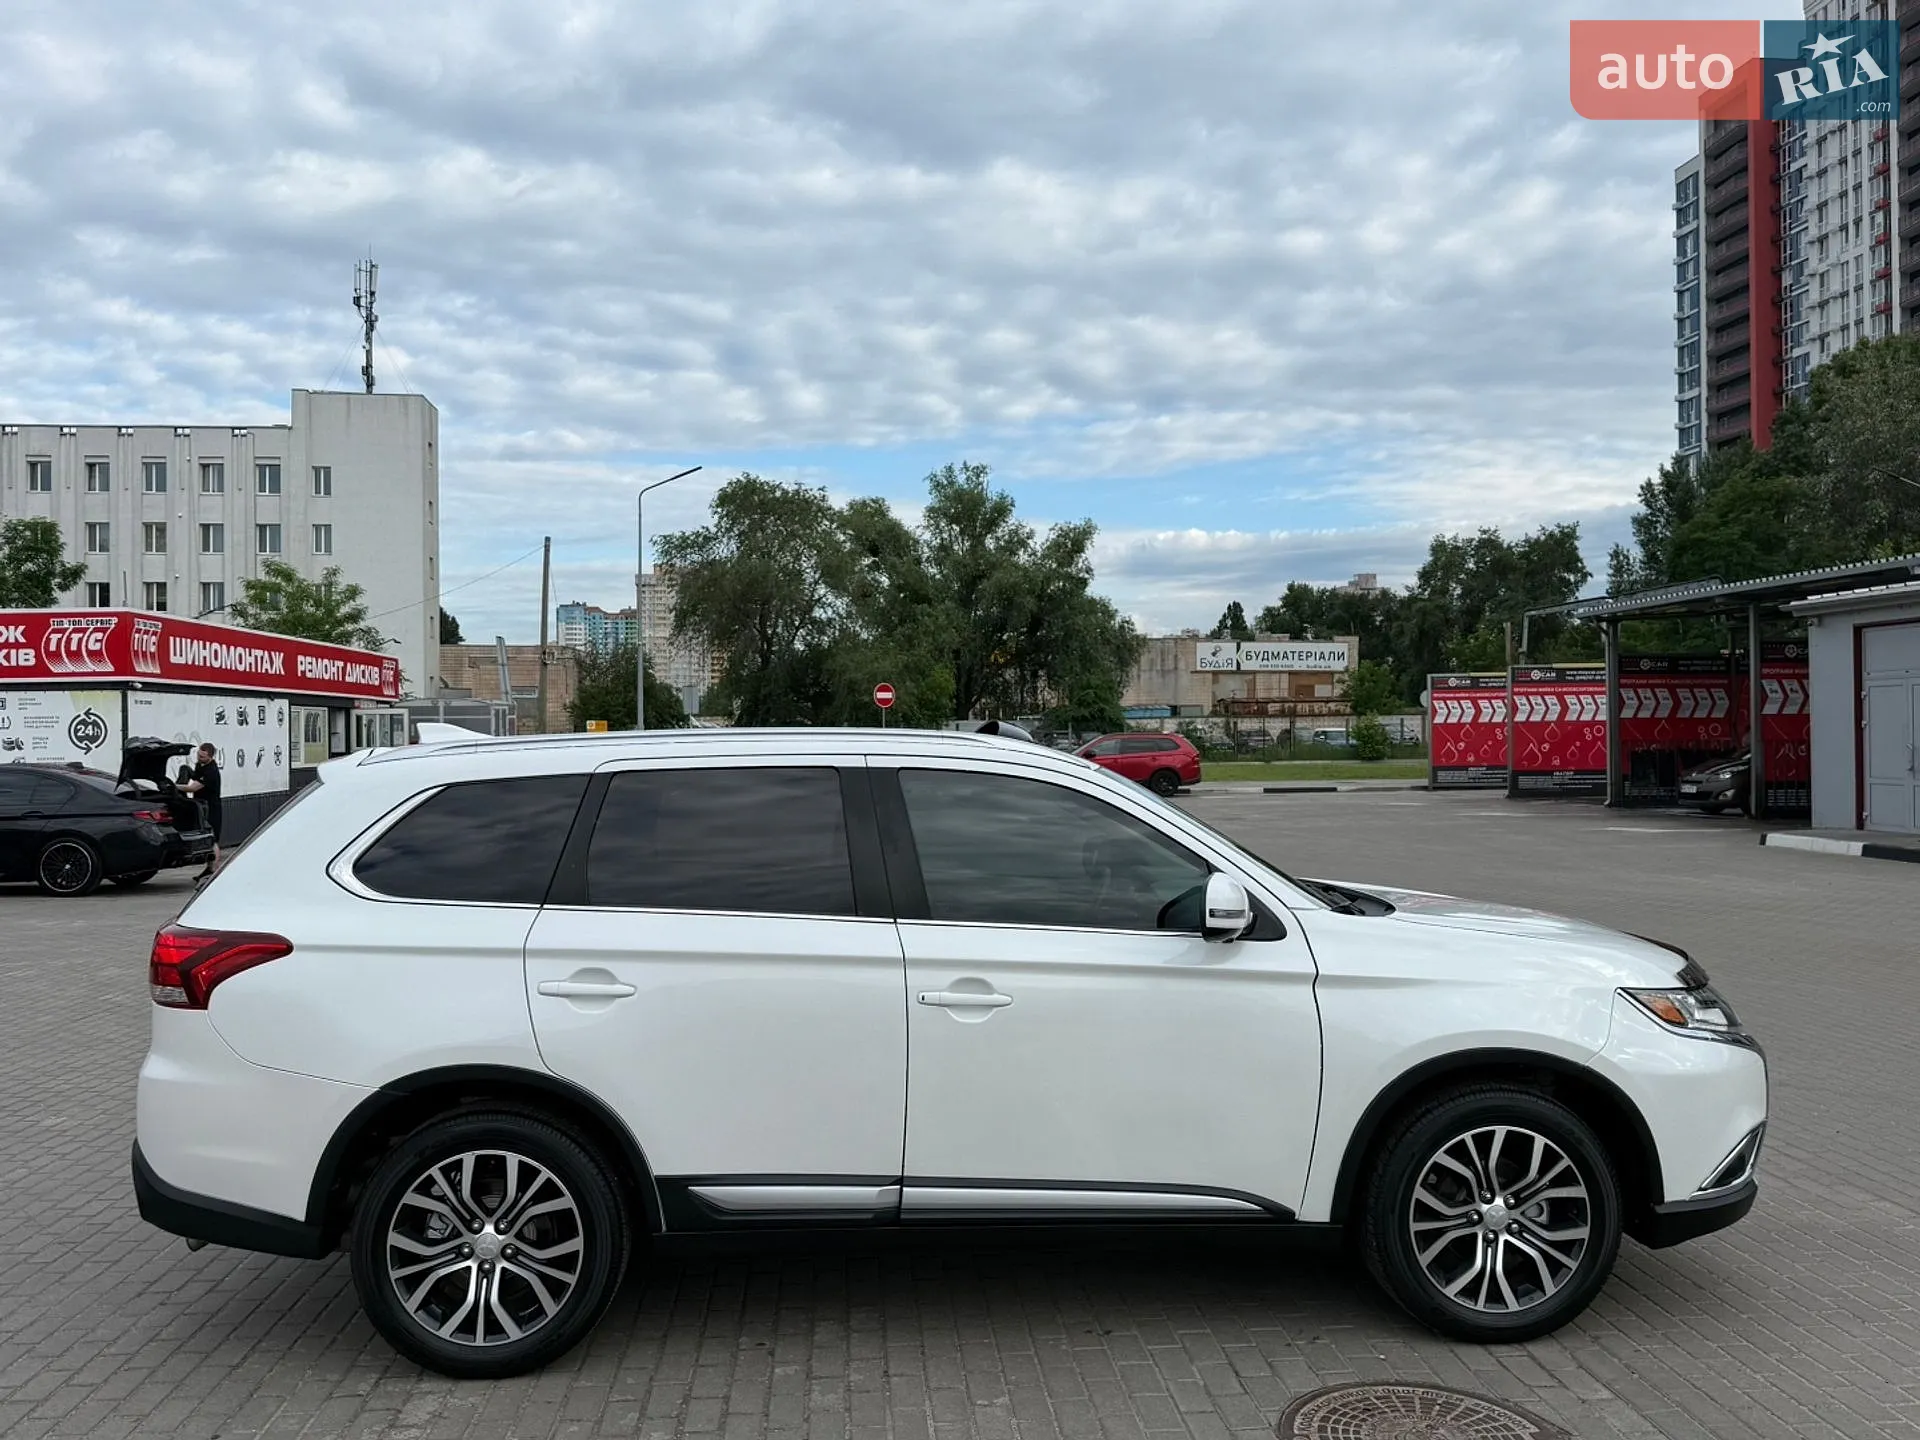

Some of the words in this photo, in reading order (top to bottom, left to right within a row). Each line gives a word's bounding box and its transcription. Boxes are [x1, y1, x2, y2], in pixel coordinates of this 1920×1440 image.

[169, 635, 286, 676] ШИНОМОНТАЖ
[297, 654, 344, 681] РЕМОНТ
[345, 662, 380, 687] ДИСКІВ
[1245, 650, 1346, 662] БУДМАТЕРІАЛИ
[76, 724, 101, 737] 24h
